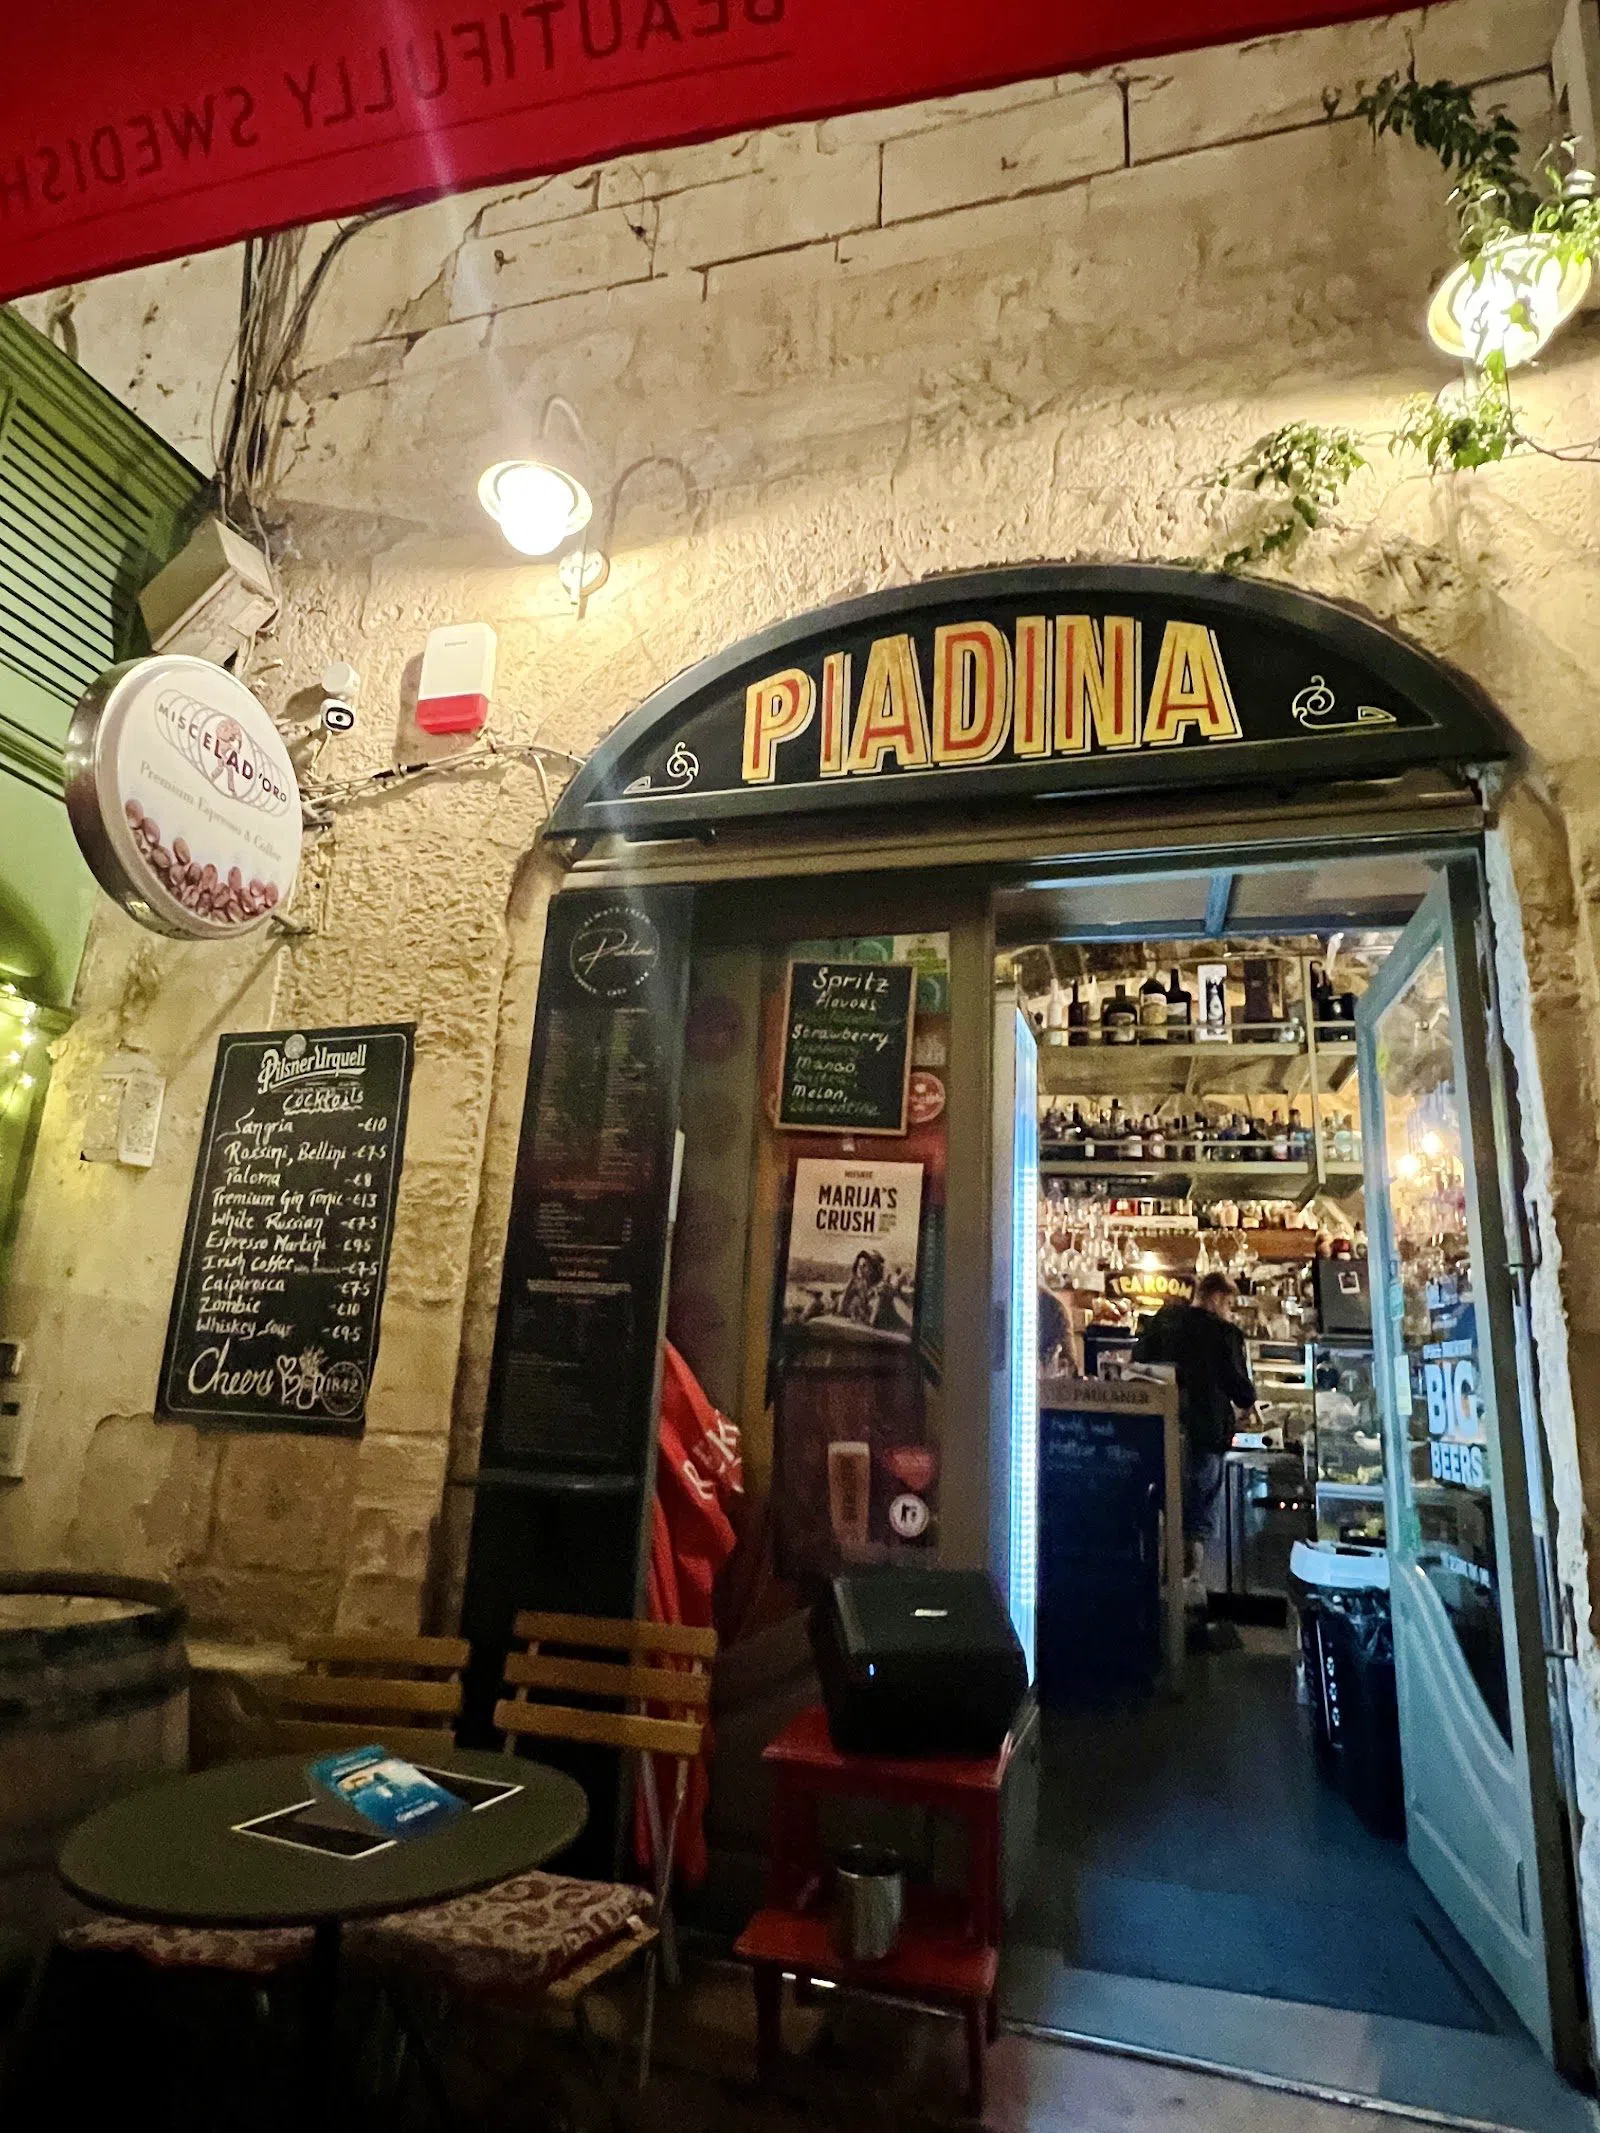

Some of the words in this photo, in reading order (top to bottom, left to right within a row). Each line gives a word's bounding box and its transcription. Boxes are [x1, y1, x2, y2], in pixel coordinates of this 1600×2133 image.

[742, 614, 1242, 787] PIADINA
[139, 759, 195, 806] Premium
[812, 966, 890, 994] Spritz
[792, 1024, 889, 1051] Strawberry
[257, 1048, 315, 1094] Pilsner
[314, 1043, 367, 1077] Urquell
[216, 1108, 295, 1144] Sangria
[223, 1165, 281, 1187] Paloma
[212, 1187, 275, 1207] Premium
[279, 1189, 304, 1214] Gin
[308, 1188, 344, 1216] Tonic
[818, 1184, 898, 1210] MARIJA'S
[211, 1208, 254, 1237] White
[265, 1211, 324, 1237] Russian
[815, 1208, 876, 1233] CRUSH
[205, 1230, 268, 1252] Espresso
[201, 1252, 246, 1275] Irish
[199, 1297, 262, 1314] Zombie
[195, 1318, 258, 1341] Whiskey
[1423, 1359, 1480, 1437] BIG
[1430, 1440, 1485, 1488] BEERS
